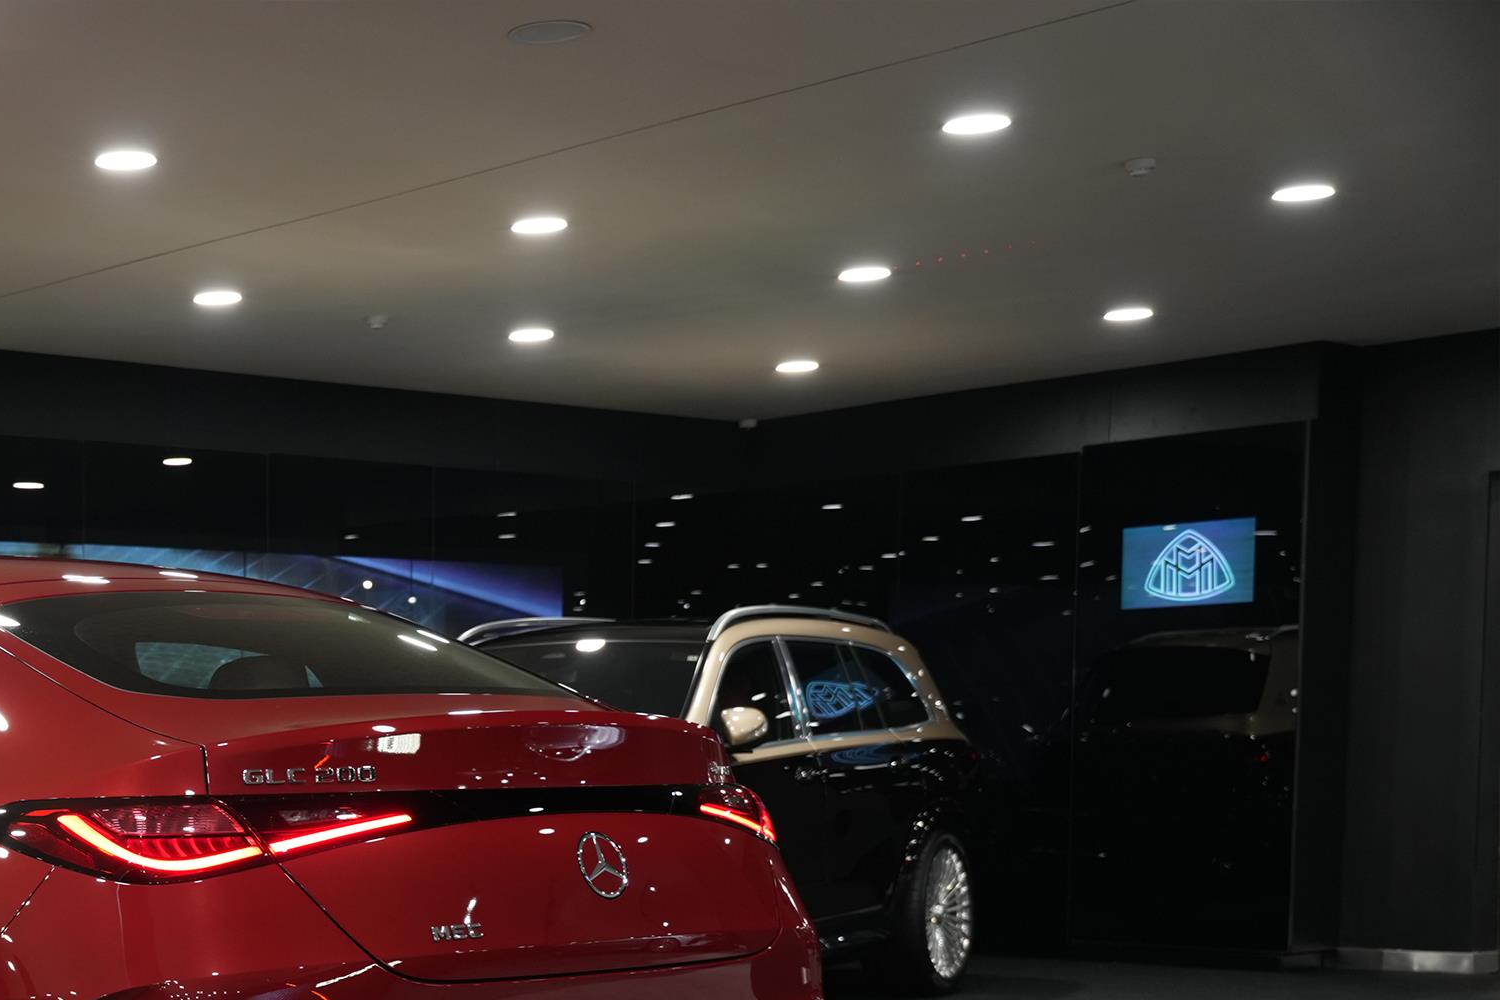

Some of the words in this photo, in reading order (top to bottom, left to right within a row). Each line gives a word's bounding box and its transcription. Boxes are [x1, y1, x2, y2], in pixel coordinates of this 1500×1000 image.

[242, 768, 307, 785] GLC
[315, 765, 377, 783] 200
[431, 922, 484, 941] MEC
